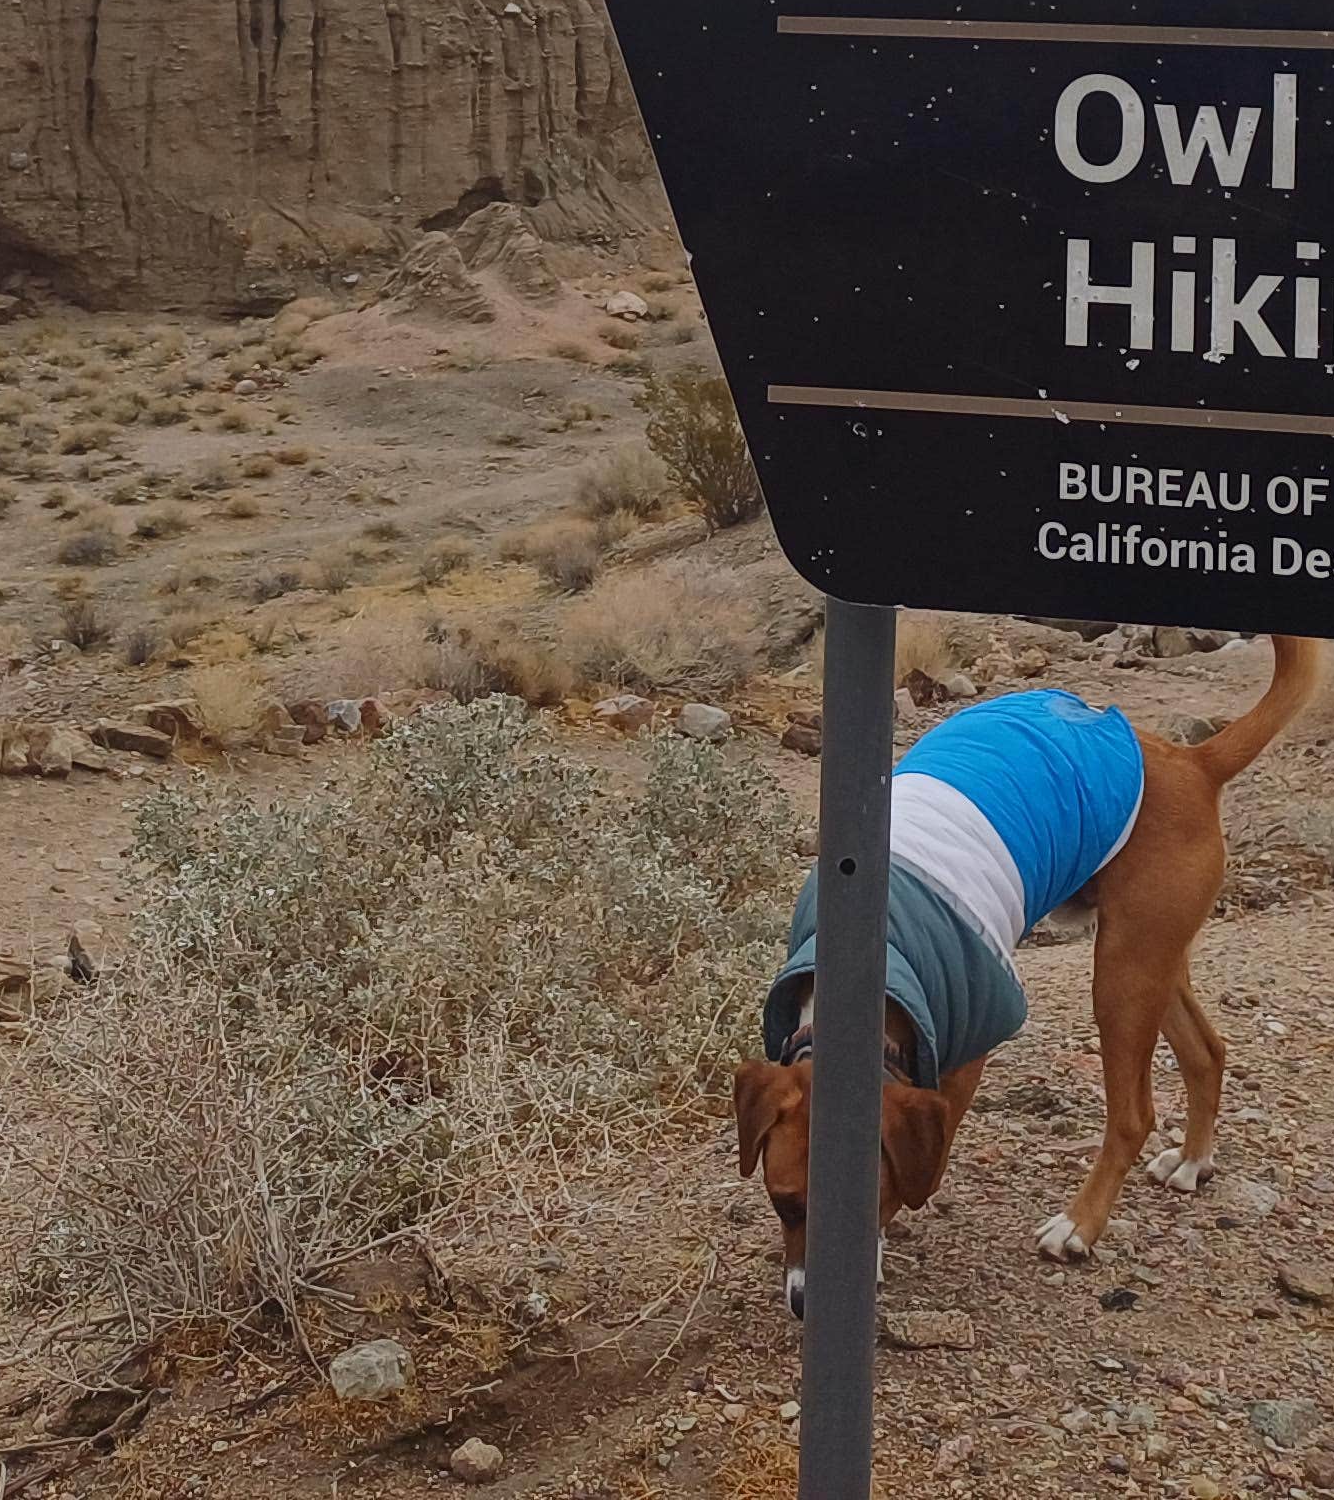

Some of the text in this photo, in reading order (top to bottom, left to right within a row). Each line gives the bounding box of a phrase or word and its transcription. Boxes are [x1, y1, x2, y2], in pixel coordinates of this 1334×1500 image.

[1054, 72, 1300, 190] Owl
[1058, 462, 1250, 512] BUREAU
[1266, 475, 1330, 516] OF
[1038, 521, 1256, 573] California
